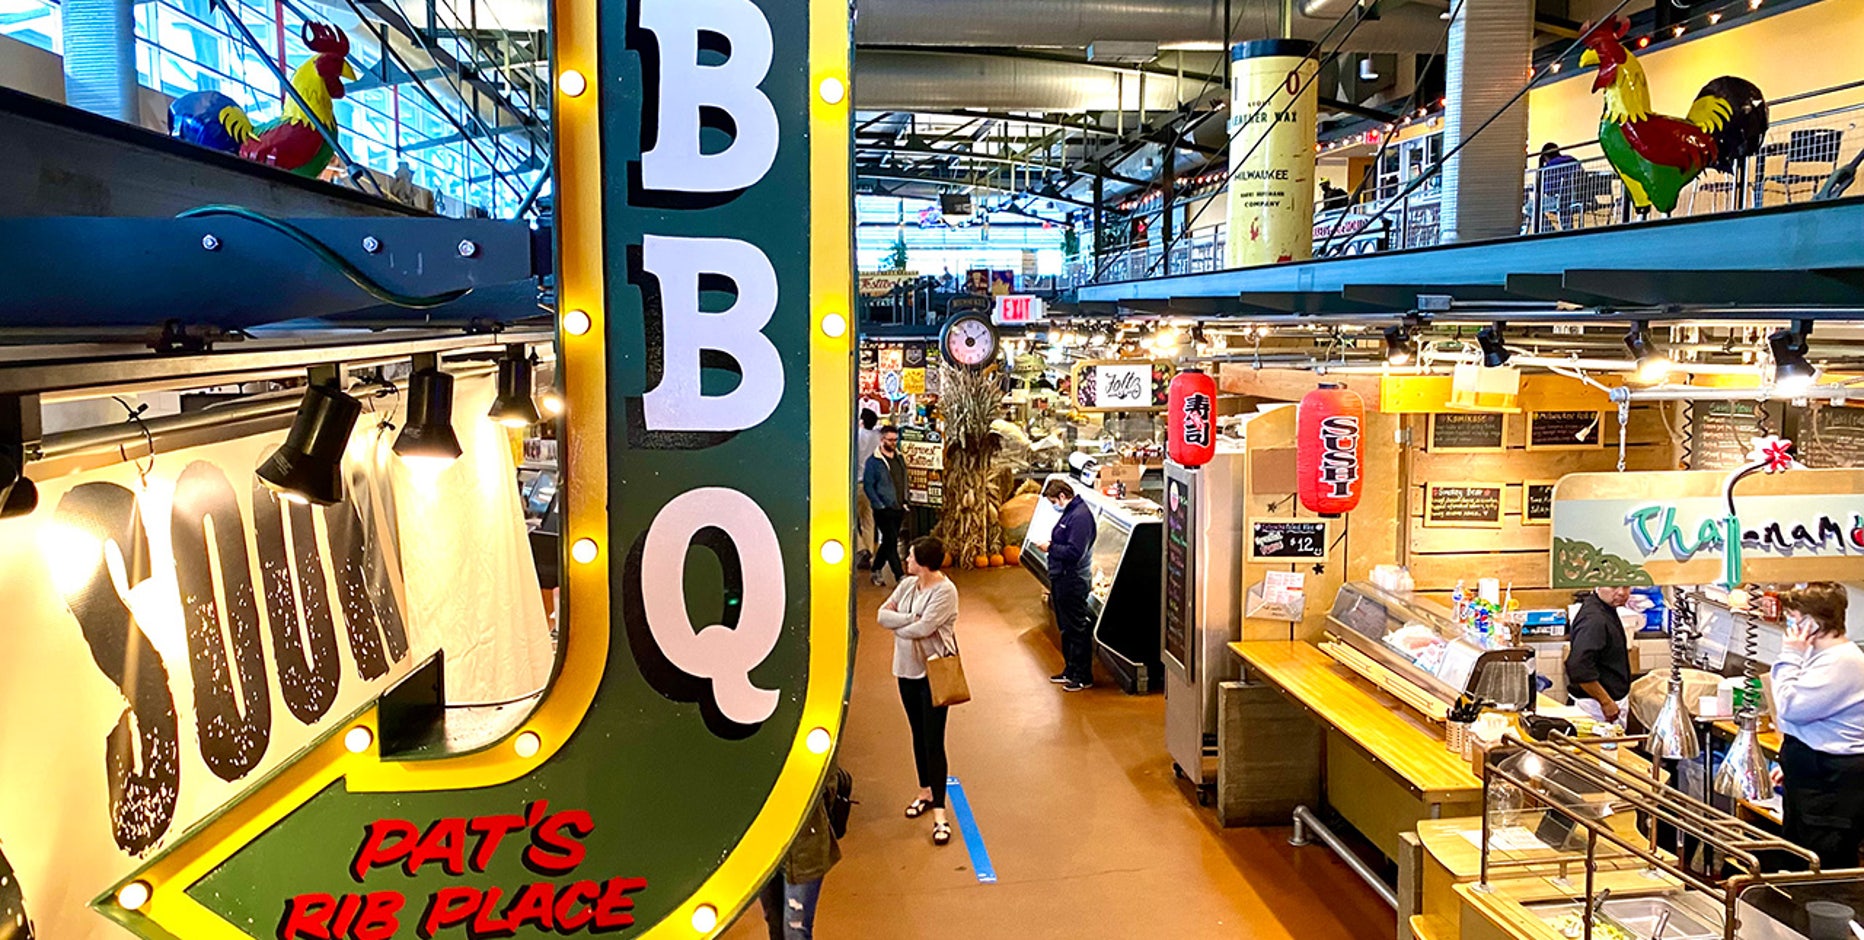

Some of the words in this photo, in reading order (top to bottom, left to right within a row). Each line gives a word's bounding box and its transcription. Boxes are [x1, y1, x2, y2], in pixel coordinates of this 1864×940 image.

[1274, 111, 1297, 122] WAX
[1234, 169, 1288, 181] MILWAUKEE
[1003, 298, 1031, 320] EXIT
[640, 0, 786, 724] BBQ
[1319, 416, 1360, 498] SUSHI
[1290, 536, 1314, 552] $12
[354, 799, 595, 882] PAT'S
[278, 890, 406, 940] RIB
[417, 877, 648, 938] PLACE
